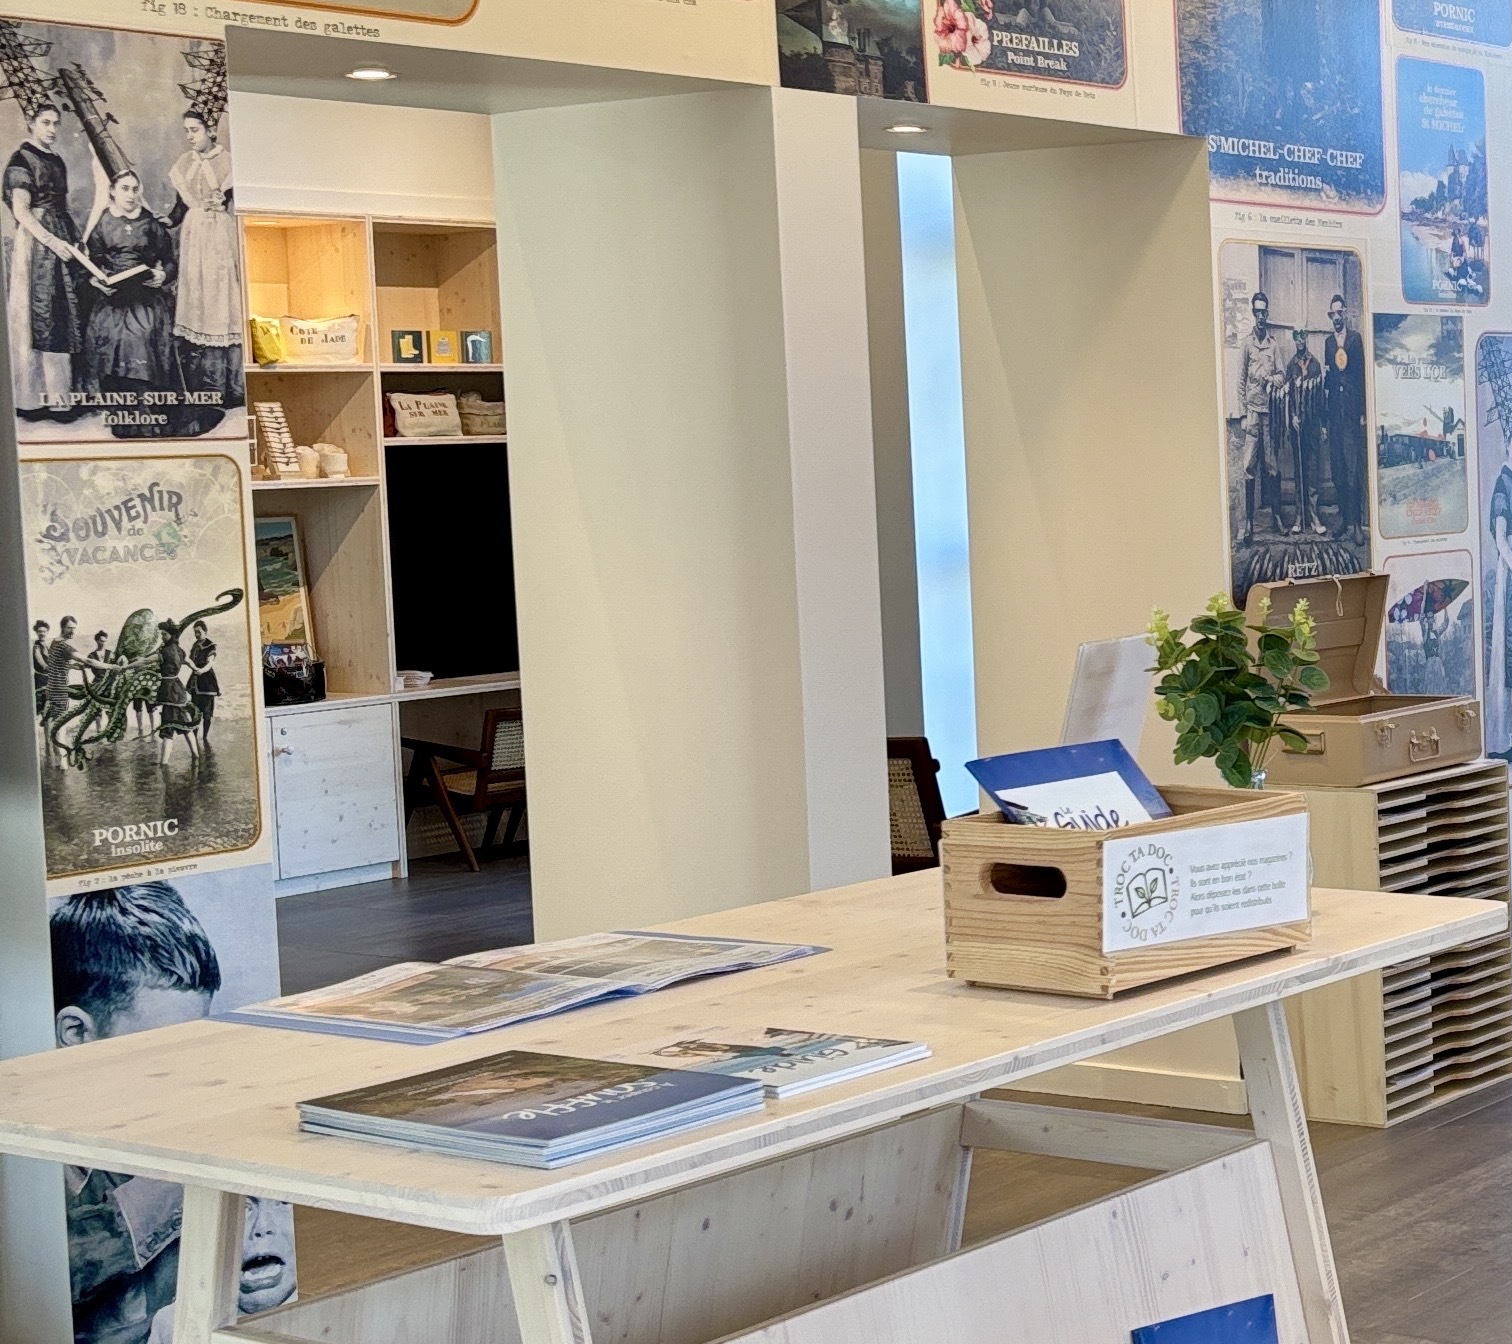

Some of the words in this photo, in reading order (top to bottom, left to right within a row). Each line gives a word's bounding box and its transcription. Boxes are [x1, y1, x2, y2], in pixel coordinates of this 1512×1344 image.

[141, 0, 167, 17] fig
[205, 6, 289, 28] Chargement
[295, 17, 318, 30] des
[324, 21, 381, 39] galettes
[1432, 1, 1476, 23] PORNIC
[992, 30, 1079, 57] PREFAILLES
[1007, 51, 1035, 66] Point
[1037, 55, 1068, 70] Break
[1255, 165, 1323, 189] traditions
[301, 337, 313, 345] DE
[70, 391, 223, 406] PLAINE-SUR-MER
[101, 411, 168, 426] folklore
[42, 482, 183, 543] SOUVENIR
[127, 525, 144, 537] de
[63, 543, 179, 566] VACANCES
[1288, 563, 1317, 577] RETZ
[92, 818, 179, 846] PORNIC
[111, 839, 164, 856] insolite
[1114, 861, 1131, 909] TROC
[1128, 849, 1145, 863] TA
[1148, 843, 1173, 867] DOC
[1164, 876, 1179, 923] TROC
[1122, 919, 1148, 942] DOC
[1150, 921, 1167, 937] TA
